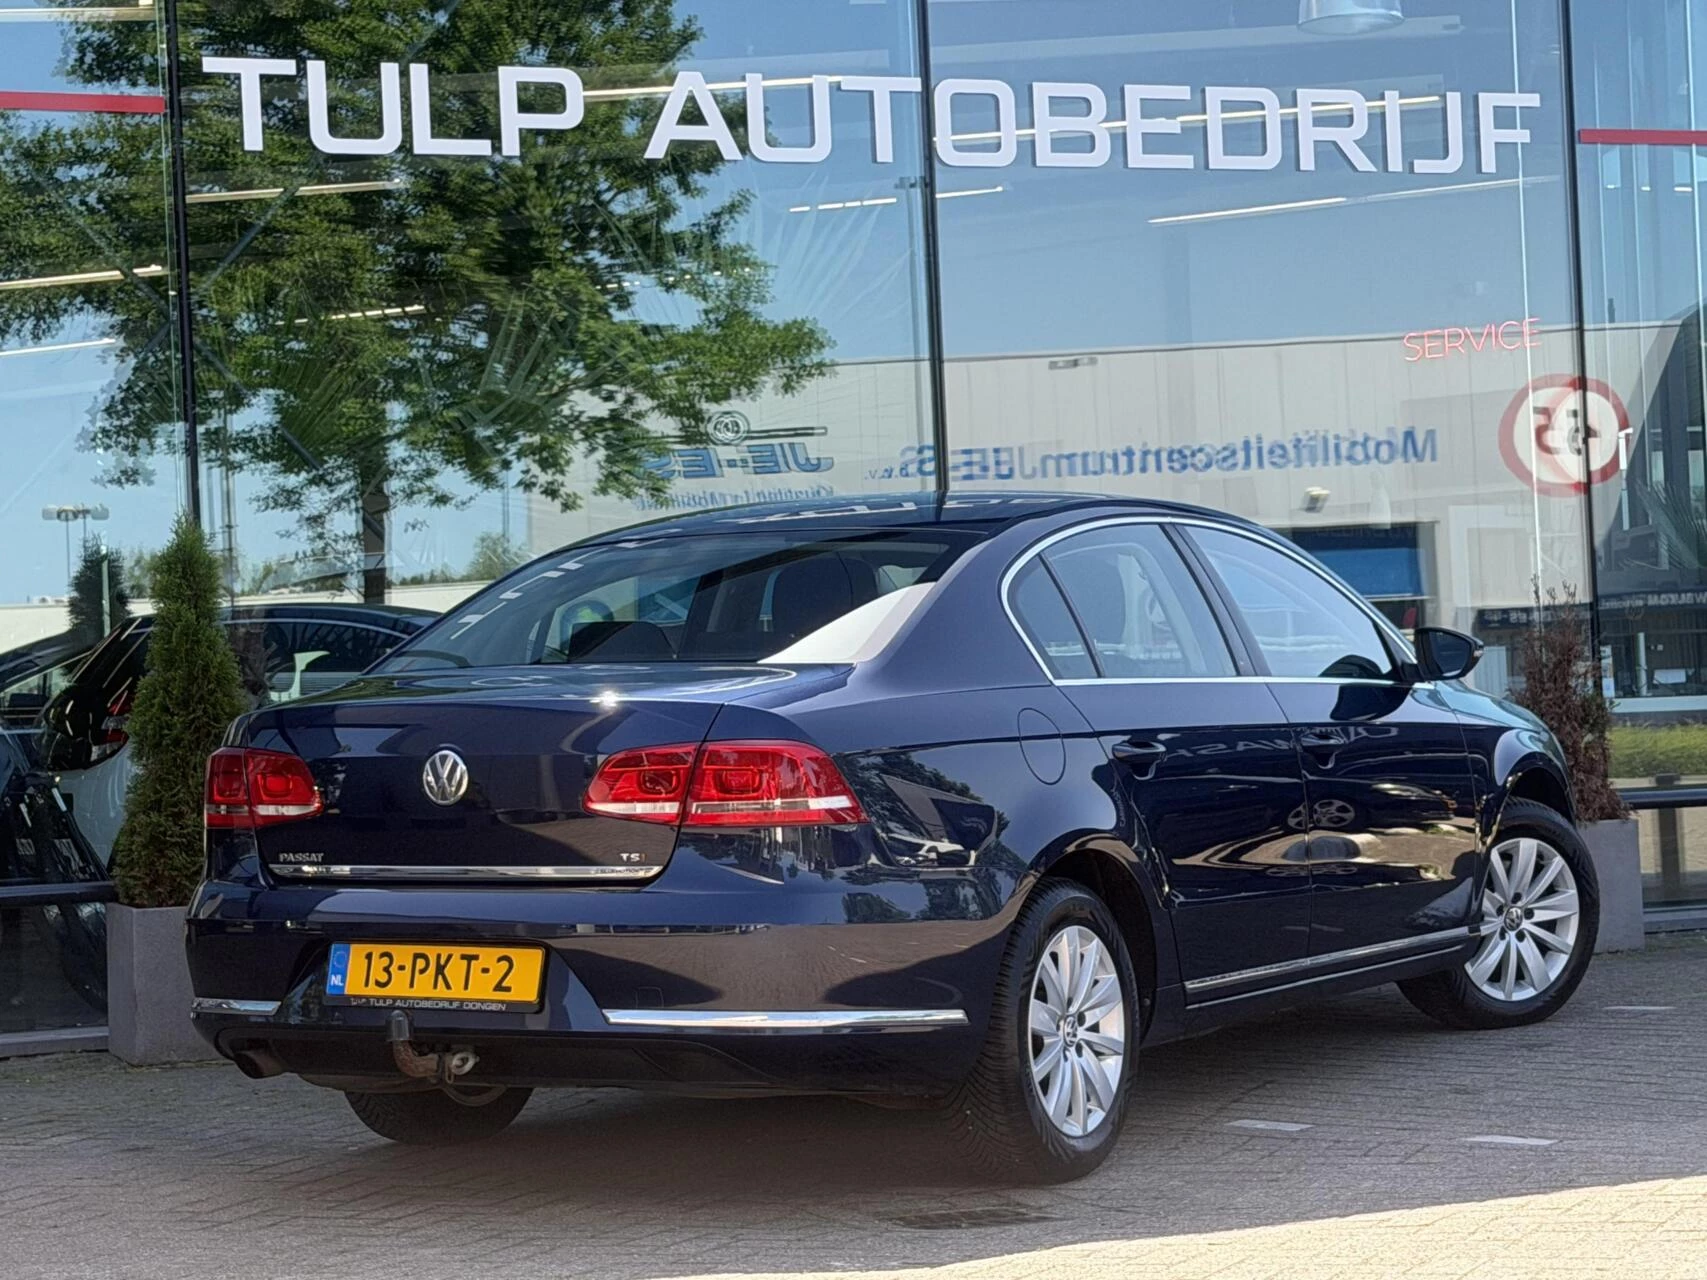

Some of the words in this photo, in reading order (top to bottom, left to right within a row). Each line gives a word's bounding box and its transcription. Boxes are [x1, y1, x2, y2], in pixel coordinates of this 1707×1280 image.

[202, 56, 585, 157] TULP
[643, 71, 1541, 174] AUTOBEDRIJF
[1403, 317, 1542, 362] SERVICE
[279, 852, 325, 863] PASSAT
[620, 853, 647, 862] TSI
[363, 950, 515, 993] 13-PKT-2
[330, 974, 345, 987] NL
[369, 998, 393, 1007] TULP
[394, 999, 461, 1009] AUTOBEDRIJF
[462, 1001, 507, 1011] DONGEN
